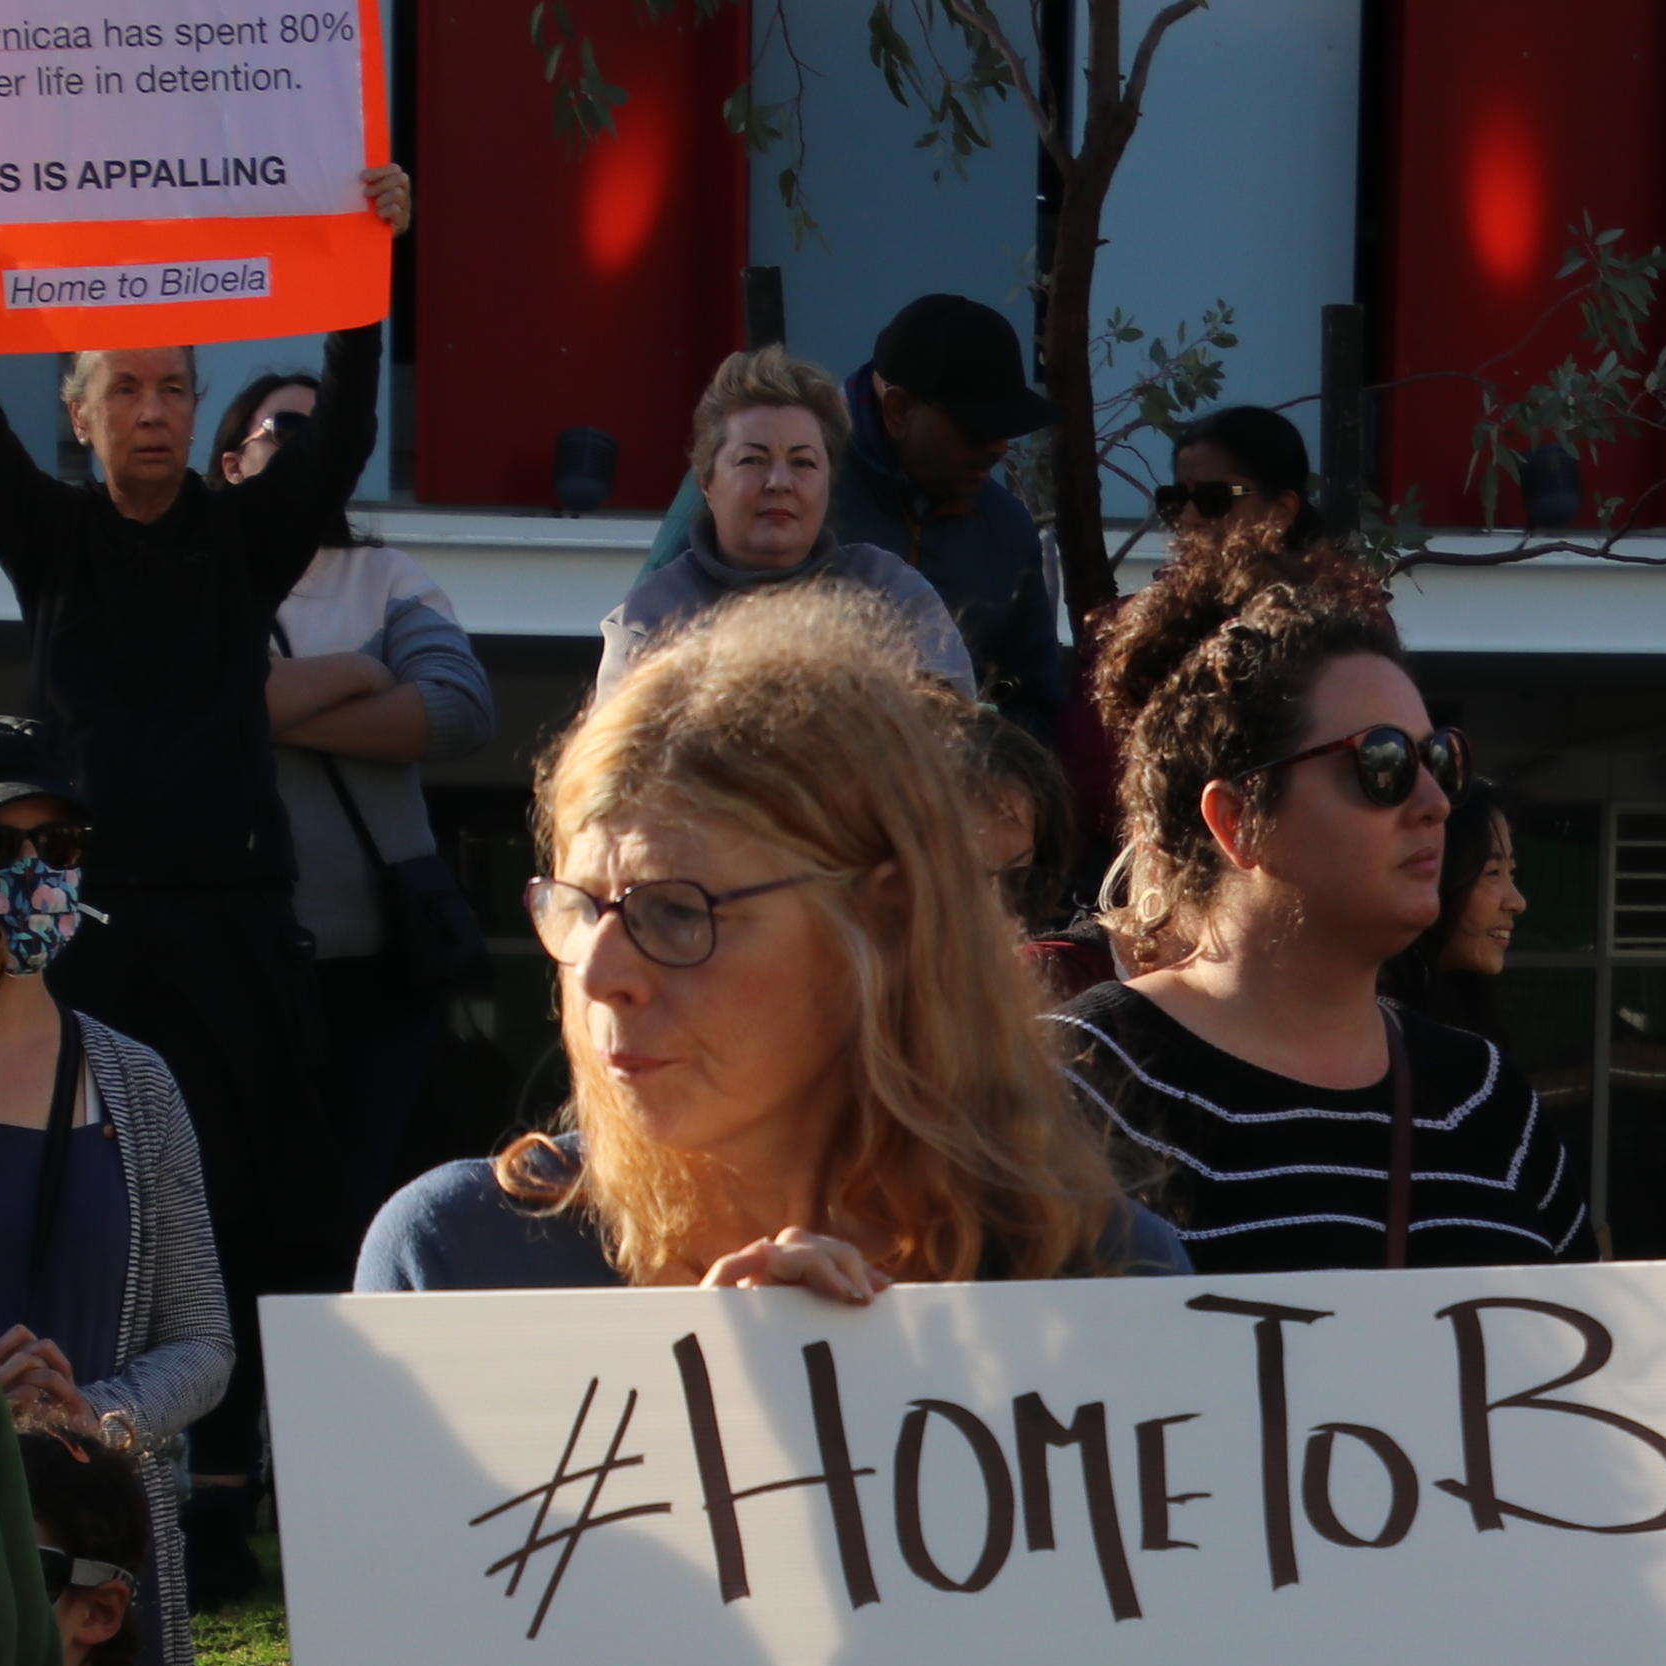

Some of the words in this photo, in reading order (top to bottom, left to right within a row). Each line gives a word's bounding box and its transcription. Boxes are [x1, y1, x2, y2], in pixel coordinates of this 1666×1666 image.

[104, 18, 163, 48] has
[175, 17, 267, 59] spent
[280, 12, 354, 43] 80%
[37, 66, 84, 96] life
[96, 65, 123, 95] in
[136, 63, 301, 95] detention.
[34, 161, 67, 191] IS
[77, 156, 286, 189] APPALLING
[10, 273, 106, 304] Home
[117, 272, 147, 299] to
[160, 266, 266, 295] Biloela
